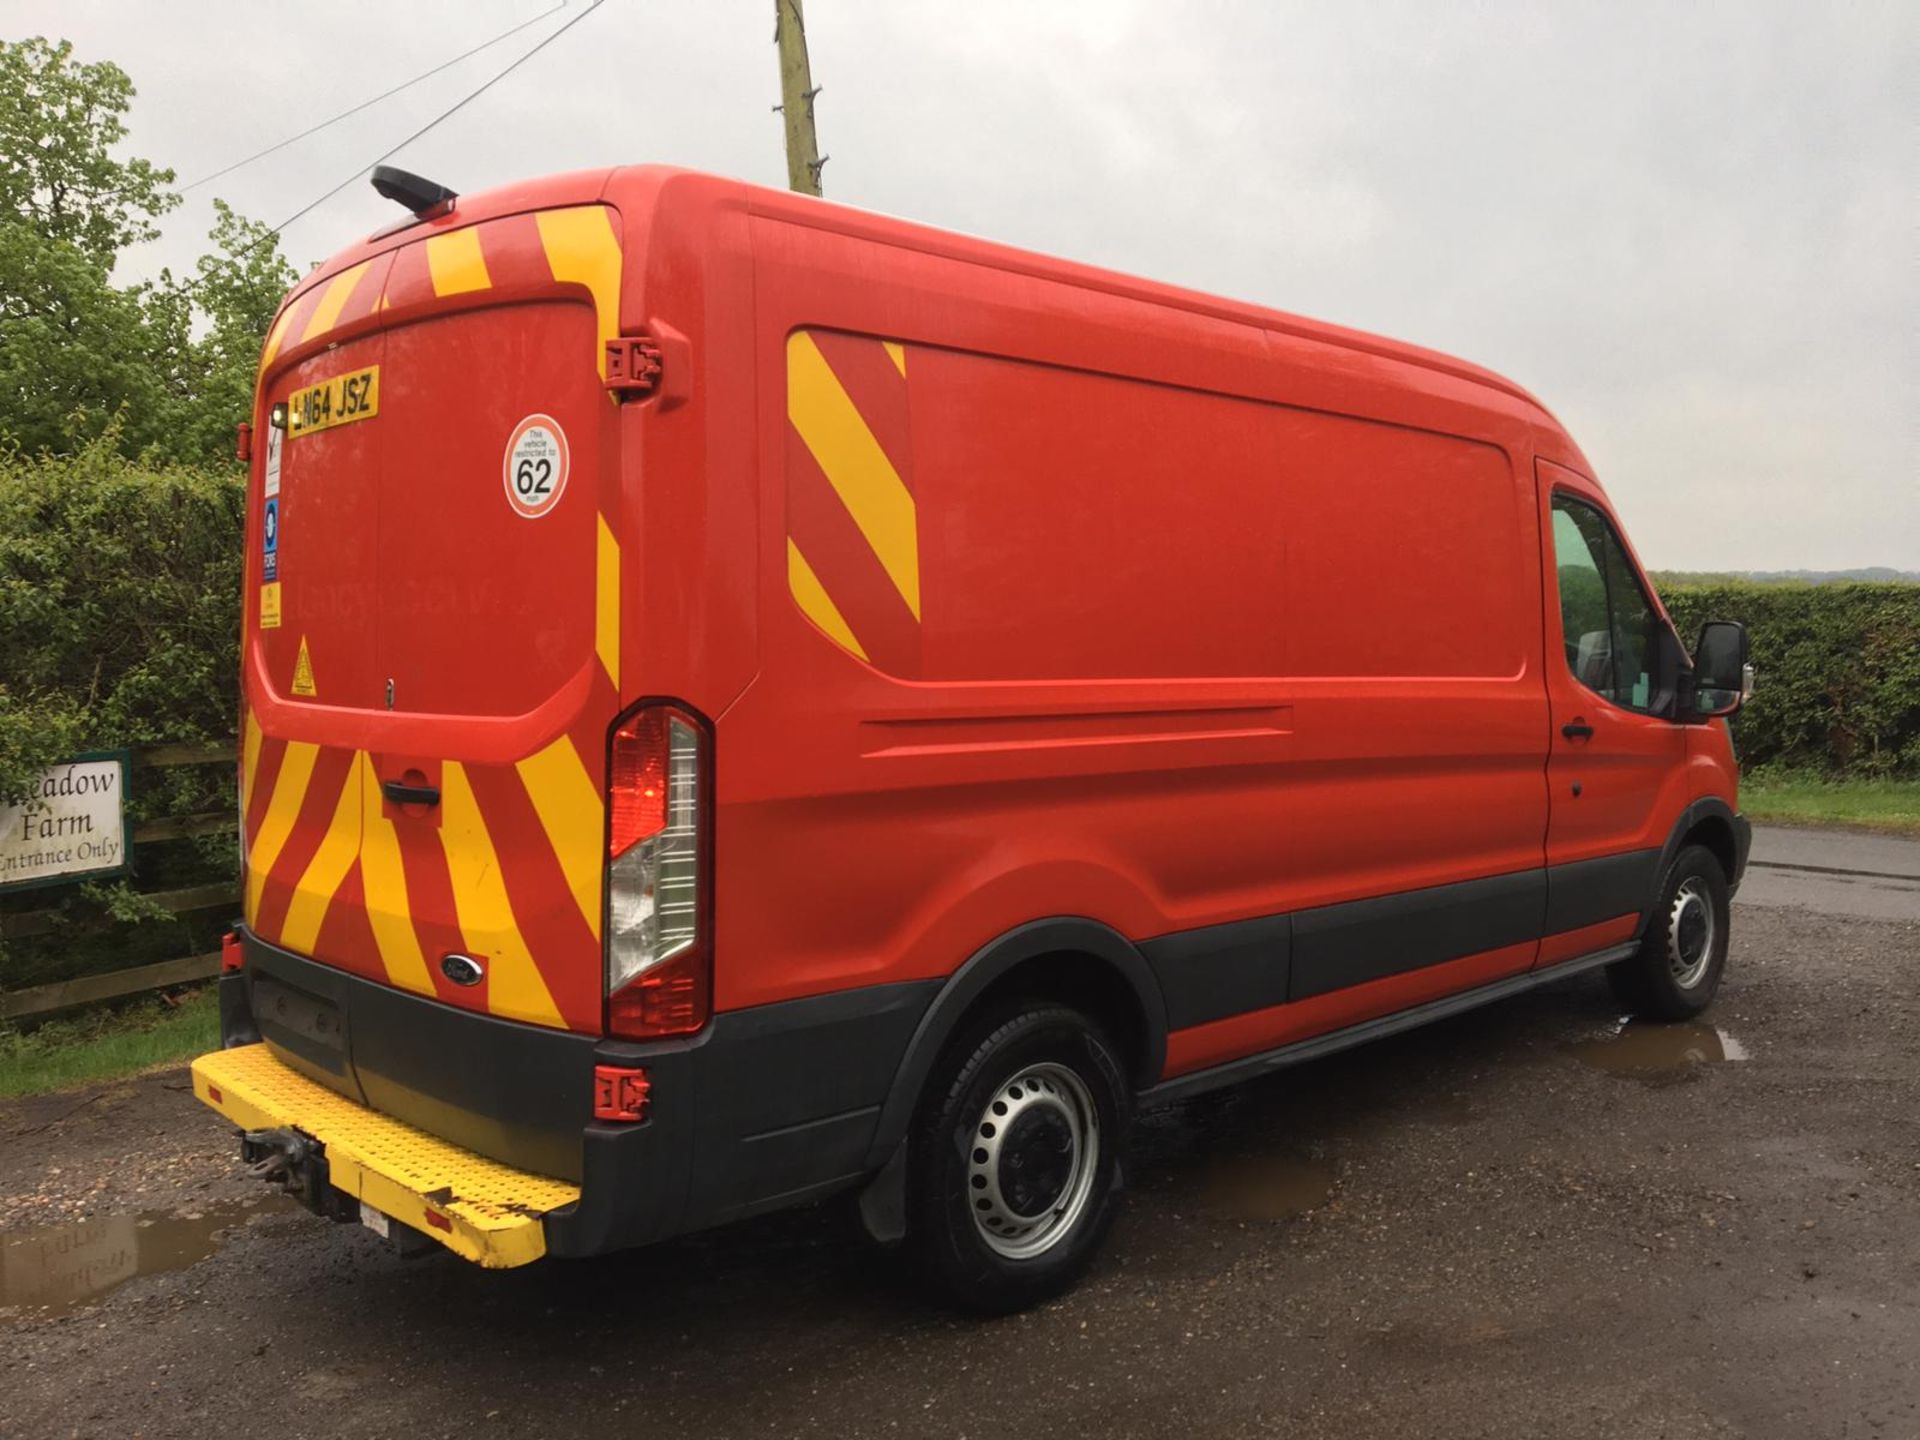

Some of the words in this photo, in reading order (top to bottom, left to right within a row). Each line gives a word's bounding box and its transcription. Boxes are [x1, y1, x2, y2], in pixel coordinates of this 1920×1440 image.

[336, 374, 372, 418] JSZ
[524, 440, 547, 448] vehicle
[529, 430, 543, 438] This
[514, 449, 546, 457] restricted
[517, 458, 551, 495] 62
[24, 765, 114, 801] eadow
[21, 813, 94, 841] Farm
[77, 836, 119, 864] Only
